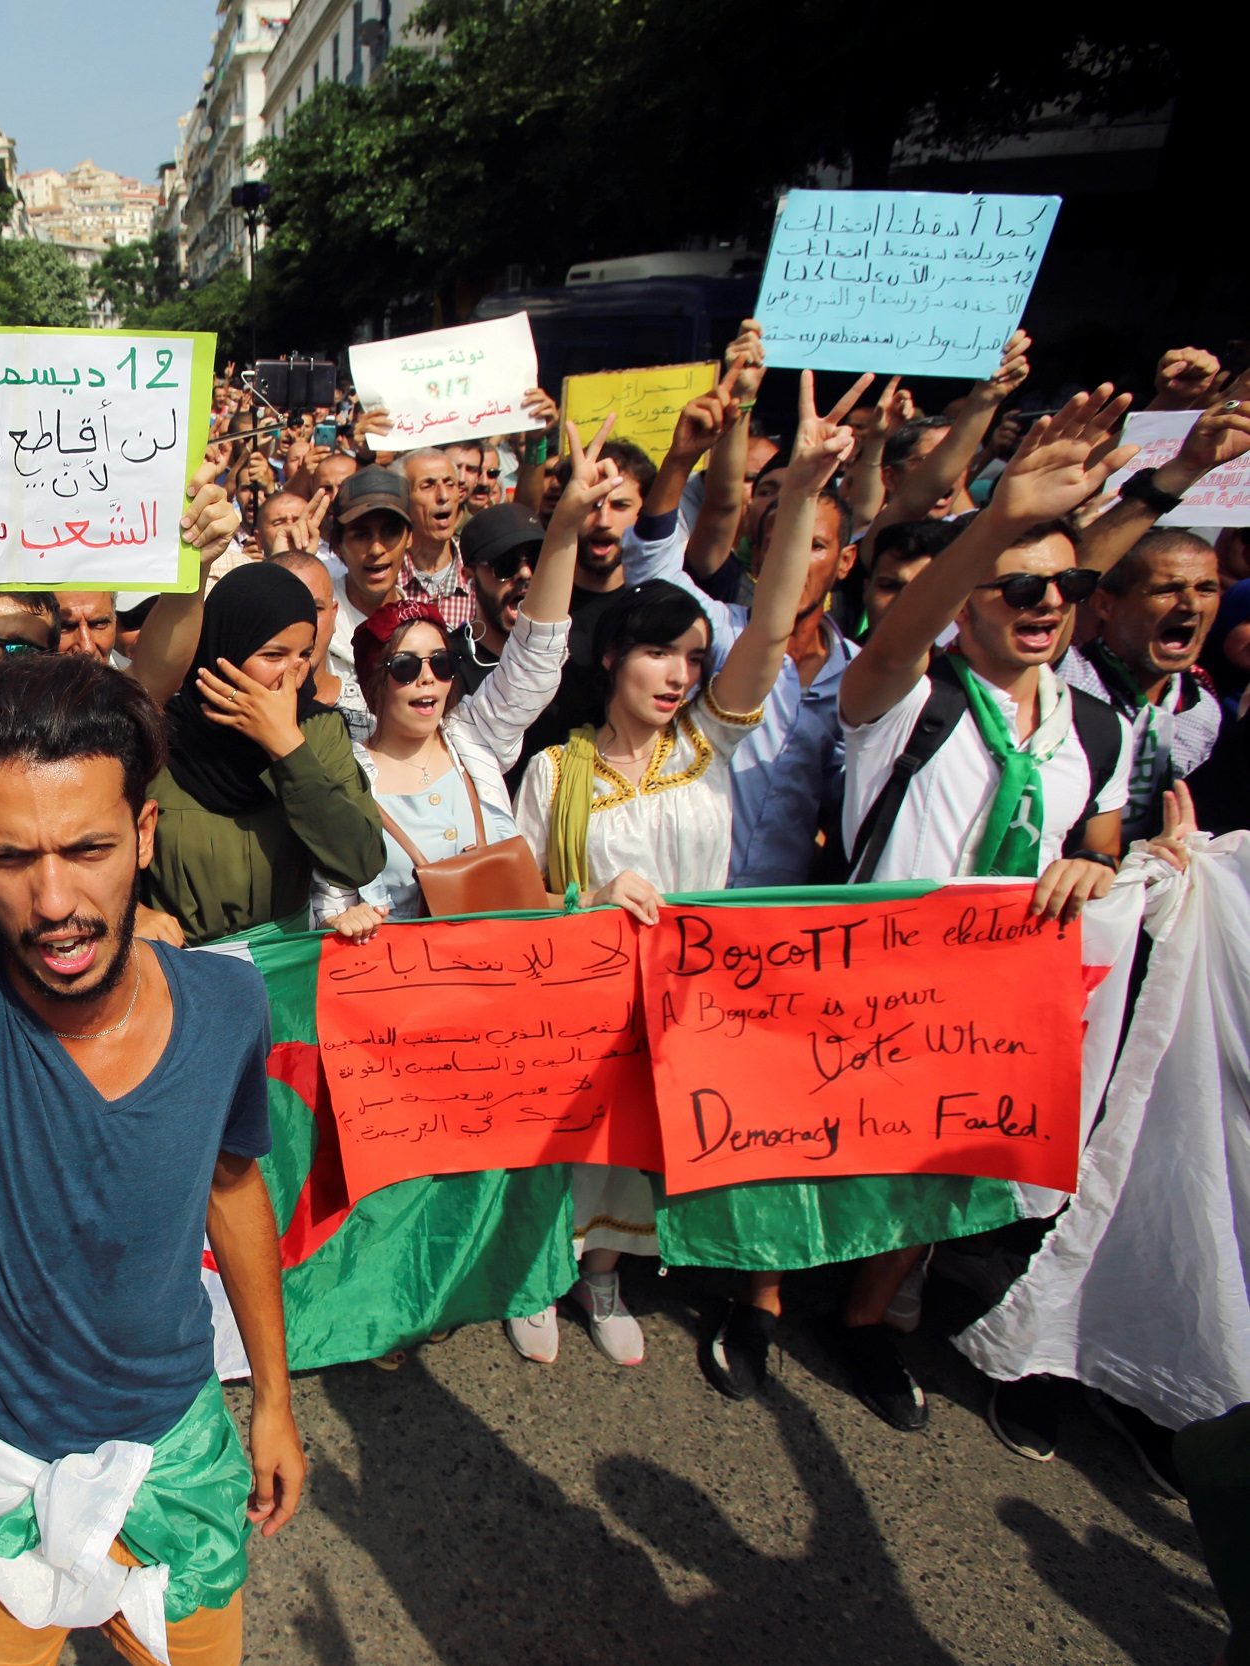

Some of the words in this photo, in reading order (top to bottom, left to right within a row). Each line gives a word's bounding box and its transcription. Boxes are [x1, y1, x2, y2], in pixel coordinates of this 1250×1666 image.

[995, 203, 1049, 238] كما
[954, 241, 1020, 269] جويلية
[1024, 244, 1037, 263] 4
[783, 259, 824, 283] كلنا
[1012, 270, 1033, 288] 12
[116, 346, 179, 390] 12
[448, 349, 485, 365] دولة
[467, 400, 512, 427] ماشي
[8, 398, 112, 477] أقاطع
[120, 407, 178, 463] لن
[878, 908, 922, 951] The
[581, 919, 630, 974] لا
[661, 991, 685, 1032] A
[820, 997, 845, 1018] is
[853, 987, 947, 1029] your
[402, 1031, 481, 1047] ينتخب
[485, 1019, 554, 1048] الذي
[807, 1028, 912, 1083] Vote
[925, 1020, 1038, 1056] When
[358, 1096, 393, 1115] بل
[460, 1110, 494, 1138] في
[687, 1088, 841, 1162] Democracy
[859, 1098, 912, 1137] has
